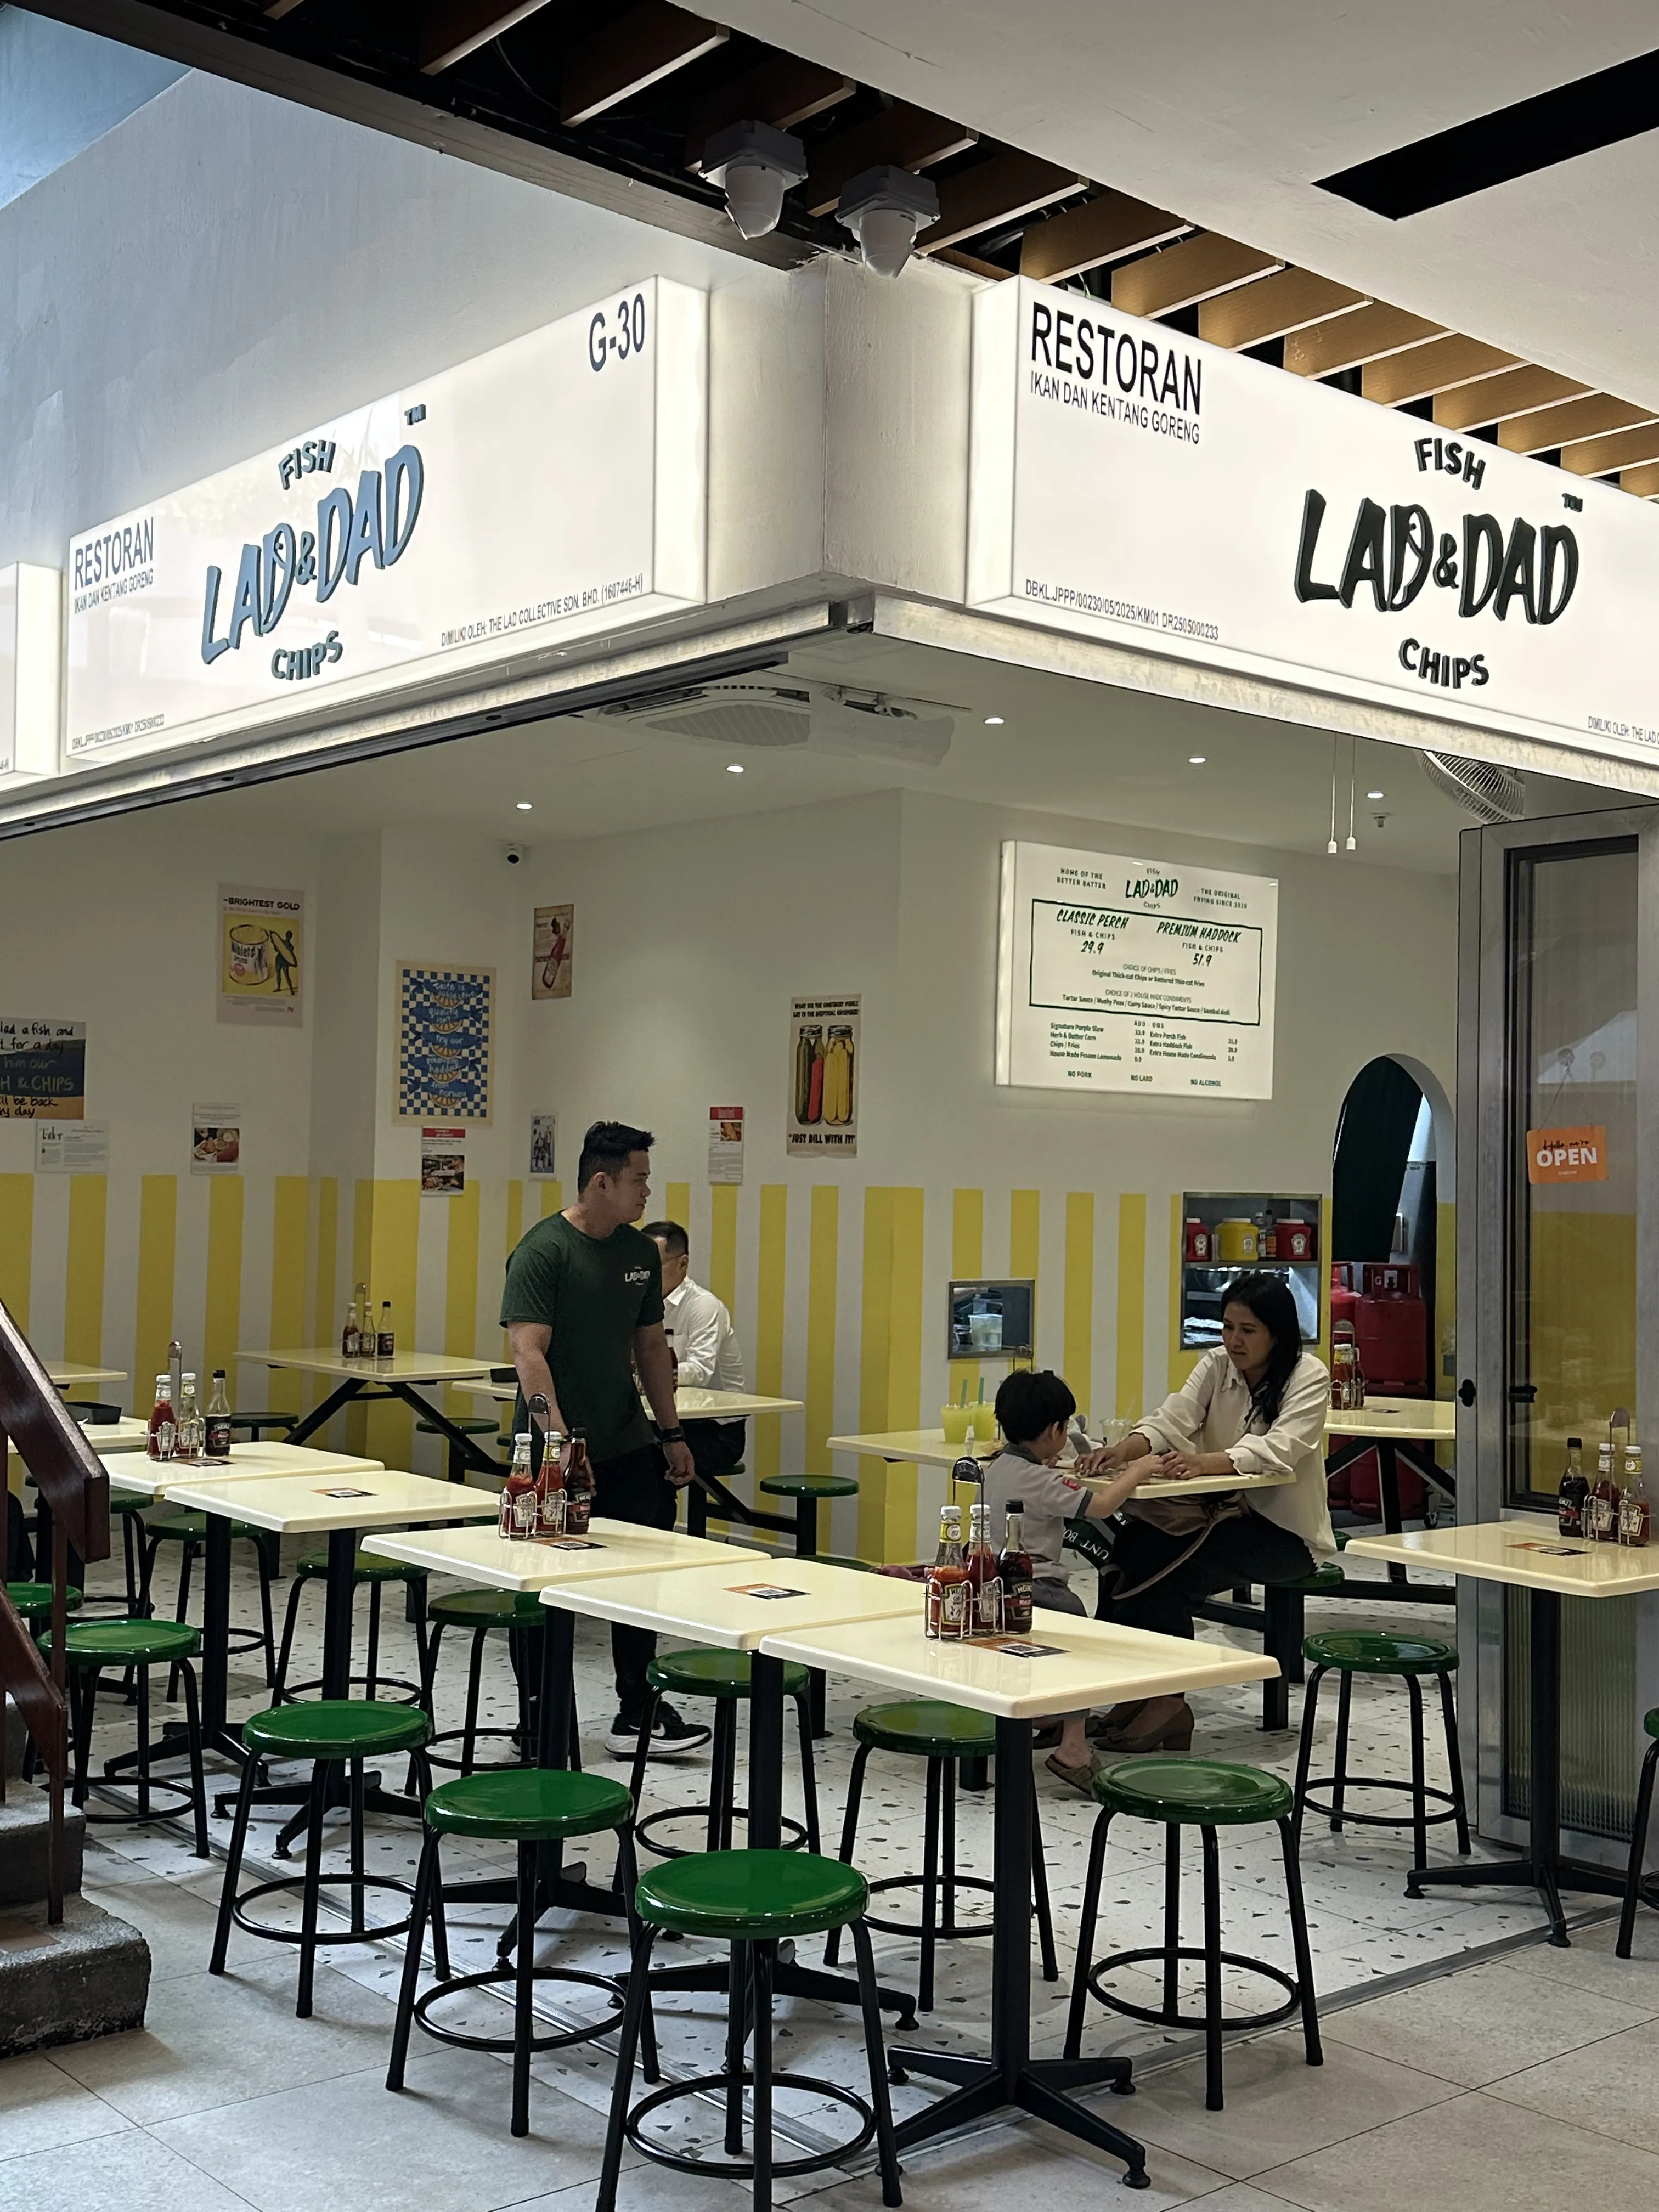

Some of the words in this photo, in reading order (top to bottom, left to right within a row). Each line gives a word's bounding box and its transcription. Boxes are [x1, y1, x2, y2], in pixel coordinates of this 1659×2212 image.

[589, 293, 645, 371] G-30
[1031, 301, 1201, 415] RESTORAN
[1031, 370, 1059, 401] IKAN
[1063, 382, 1088, 410] DAN
[1092, 390, 1148, 428] KENTANG
[1152, 410, 1200, 444] GORENG
[278, 439, 336, 490] FISH
[1414, 438, 1486, 490] FISH
[74, 517, 154, 591] RESTORAN
[75, 594, 87, 614] IKAN
[88, 588, 99, 608] DAN
[101, 578, 128, 603] KENTANG
[129, 568, 154, 592] GORENG
[489, 616, 502, 633] THE
[504, 612, 517, 629] LAD
[519, 599, 562, 624] COLLECTIVE
[563, 594, 580, 613] SDN.
[583, 588, 600, 607] BHD.
[271, 631, 343, 680] CHIPS
[1399, 637, 1489, 689] CHIPS
[1632, 726, 1643, 741] THE
[1644, 730, 1656, 743] LAD
[1060, 868, 1078, 876] HOME
[1057, 877, 1080, 885] BETTER
[1082, 880, 1106, 889] BATTER
[1214, 890, 1240, 899] ORIGINAL
[1216, 899, 1232, 907] SINCE
[277, 901, 300, 910] GOLD
[1056, 909, 1096, 926] CLASSIC
[1097, 914, 1130, 929] PERCH
[1095, 932, 1115, 940] CHIPS
[1156, 921, 1199, 939] PREMIUM
[1199, 927, 1242, 944] HADDOCK
[1081, 940, 1104, 955] 29.9
[1192, 953, 1212, 967] 51.9
[32, 1022, 51, 1036] fish
[56, 1026, 74, 1036] and
[10, 1037, 29, 1050] for
[33, 1041, 41, 1050] a
[45, 1039, 64, 1057] day
[436, 1035, 448, 1046] try
[4, 1056, 26, 1069] him
[30, 1059, 56, 1069] our
[18, 1077, 30, 1089] &
[32, 1075, 74, 1093] CHIPS
[13, 1095, 27, 1105] be
[30, 1096, 58, 1106] back
[14, 1105, 36, 1118] day
[825, 1134, 843, 1143] WITH
[1537, 1147, 1597, 1167] OPEN
